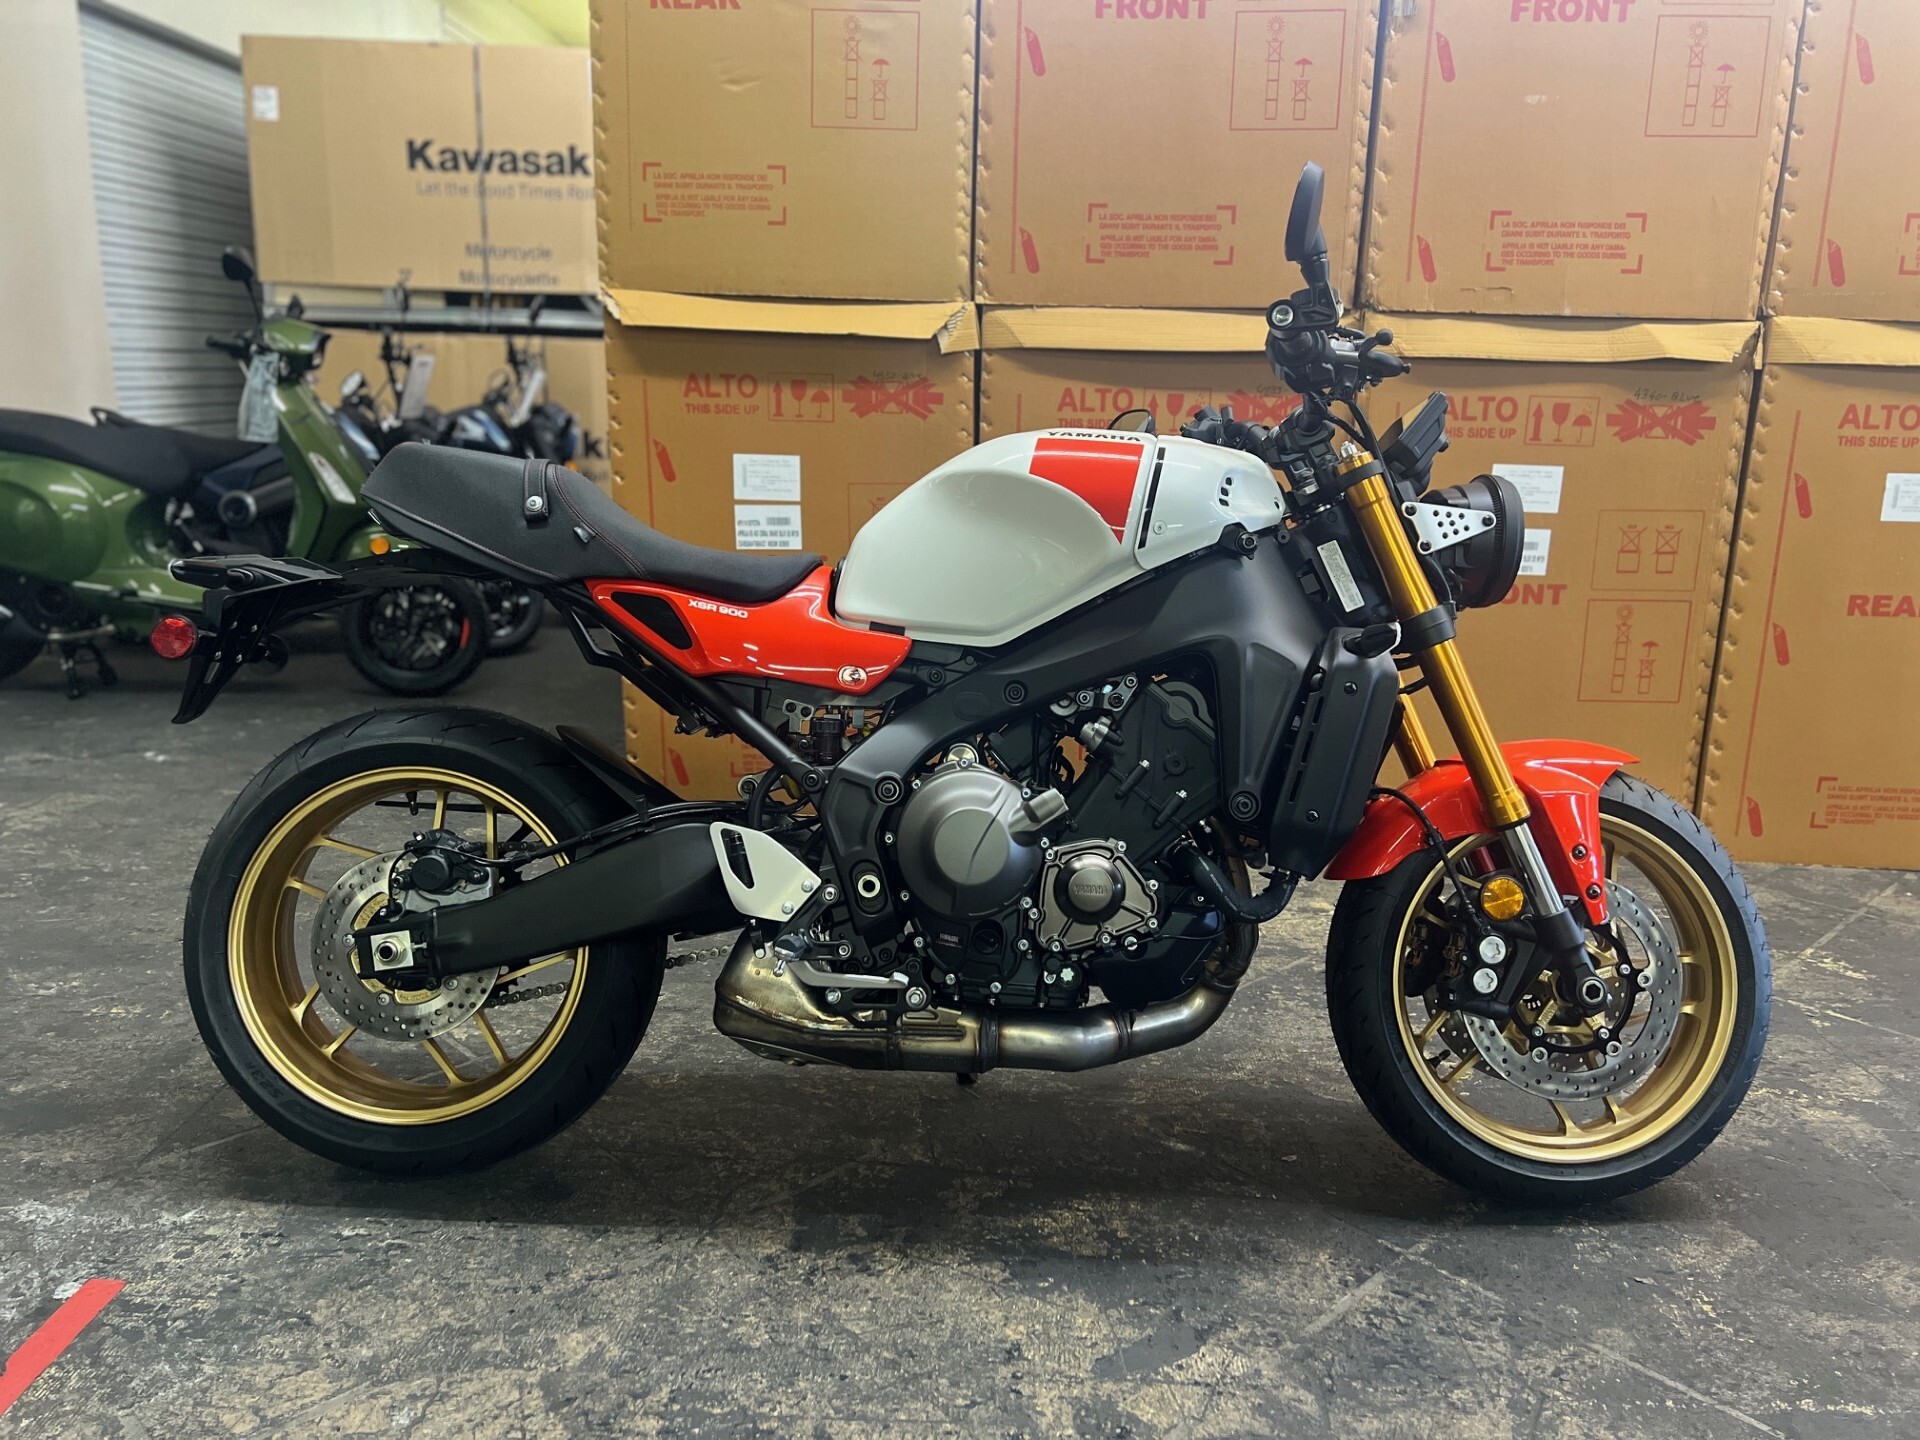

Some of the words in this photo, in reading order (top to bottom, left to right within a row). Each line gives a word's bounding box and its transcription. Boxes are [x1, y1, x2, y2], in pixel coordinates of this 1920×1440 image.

[1095, 0, 1213, 19] FRONT
[1511, 0, 1635, 22] FRONT
[407, 140, 590, 176] Kawasak
[683, 373, 758, 398] ALTO
[686, 404, 711, 413] THIS
[714, 404, 741, 414] SIDE
[744, 405, 759, 415] UP
[1057, 387, 1134, 412] ALTO
[1447, 395, 1518, 422] ALTO
[1057, 418, 1083, 428] THIS
[1838, 404, 1920, 431] ALTO
[1048, 431, 1141, 441] YAMAHA
[1446, 427, 1464, 438] HIS
[1467, 427, 1496, 438] SIDE
[1500, 428, 1516, 439] UP
[1837, 436, 1865, 447] THIS
[1869, 436, 1898, 448] SIDE
[1902, 437, 1919, 448] UP
[1501, 583, 1568, 605] ONT
[688, 599, 717, 612] XSR
[719, 605, 748, 618] 900
[1847, 595, 1920, 617] REA
[1074, 884, 1108, 896] YAMAHA
